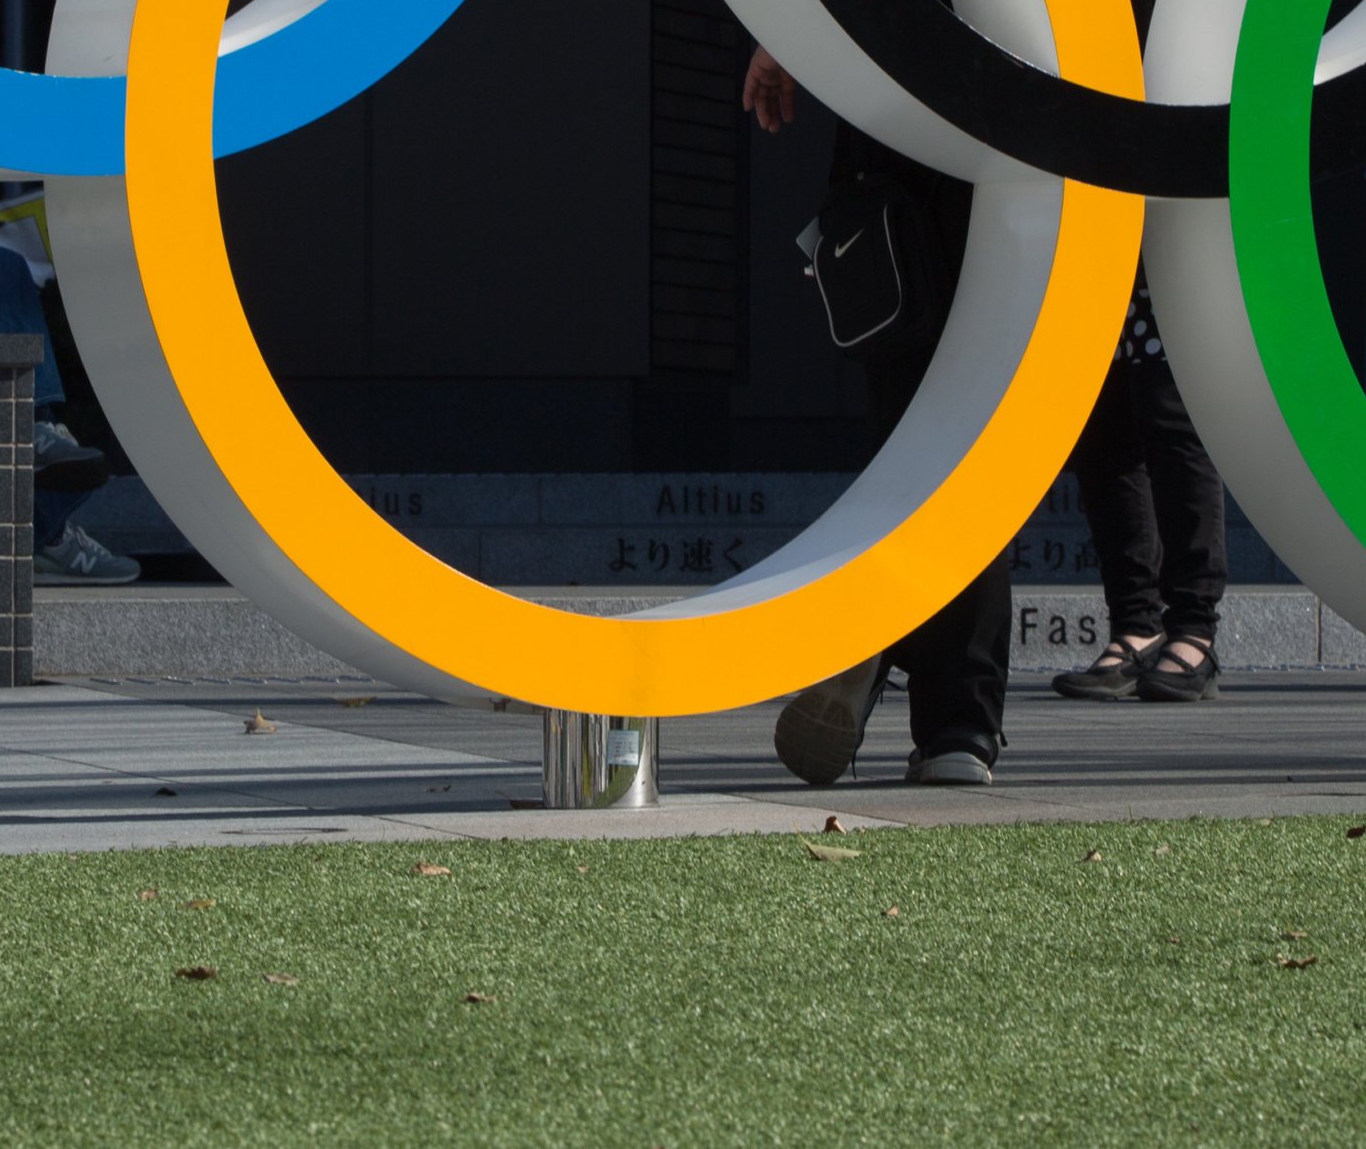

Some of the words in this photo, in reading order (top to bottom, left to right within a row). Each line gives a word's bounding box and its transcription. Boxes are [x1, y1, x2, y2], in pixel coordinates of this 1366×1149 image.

[356, 486, 423, 515] ius
[656, 485, 765, 515] Altius
[608, 537, 744, 573] より速く
[1019, 607, 1111, 645] Fas
